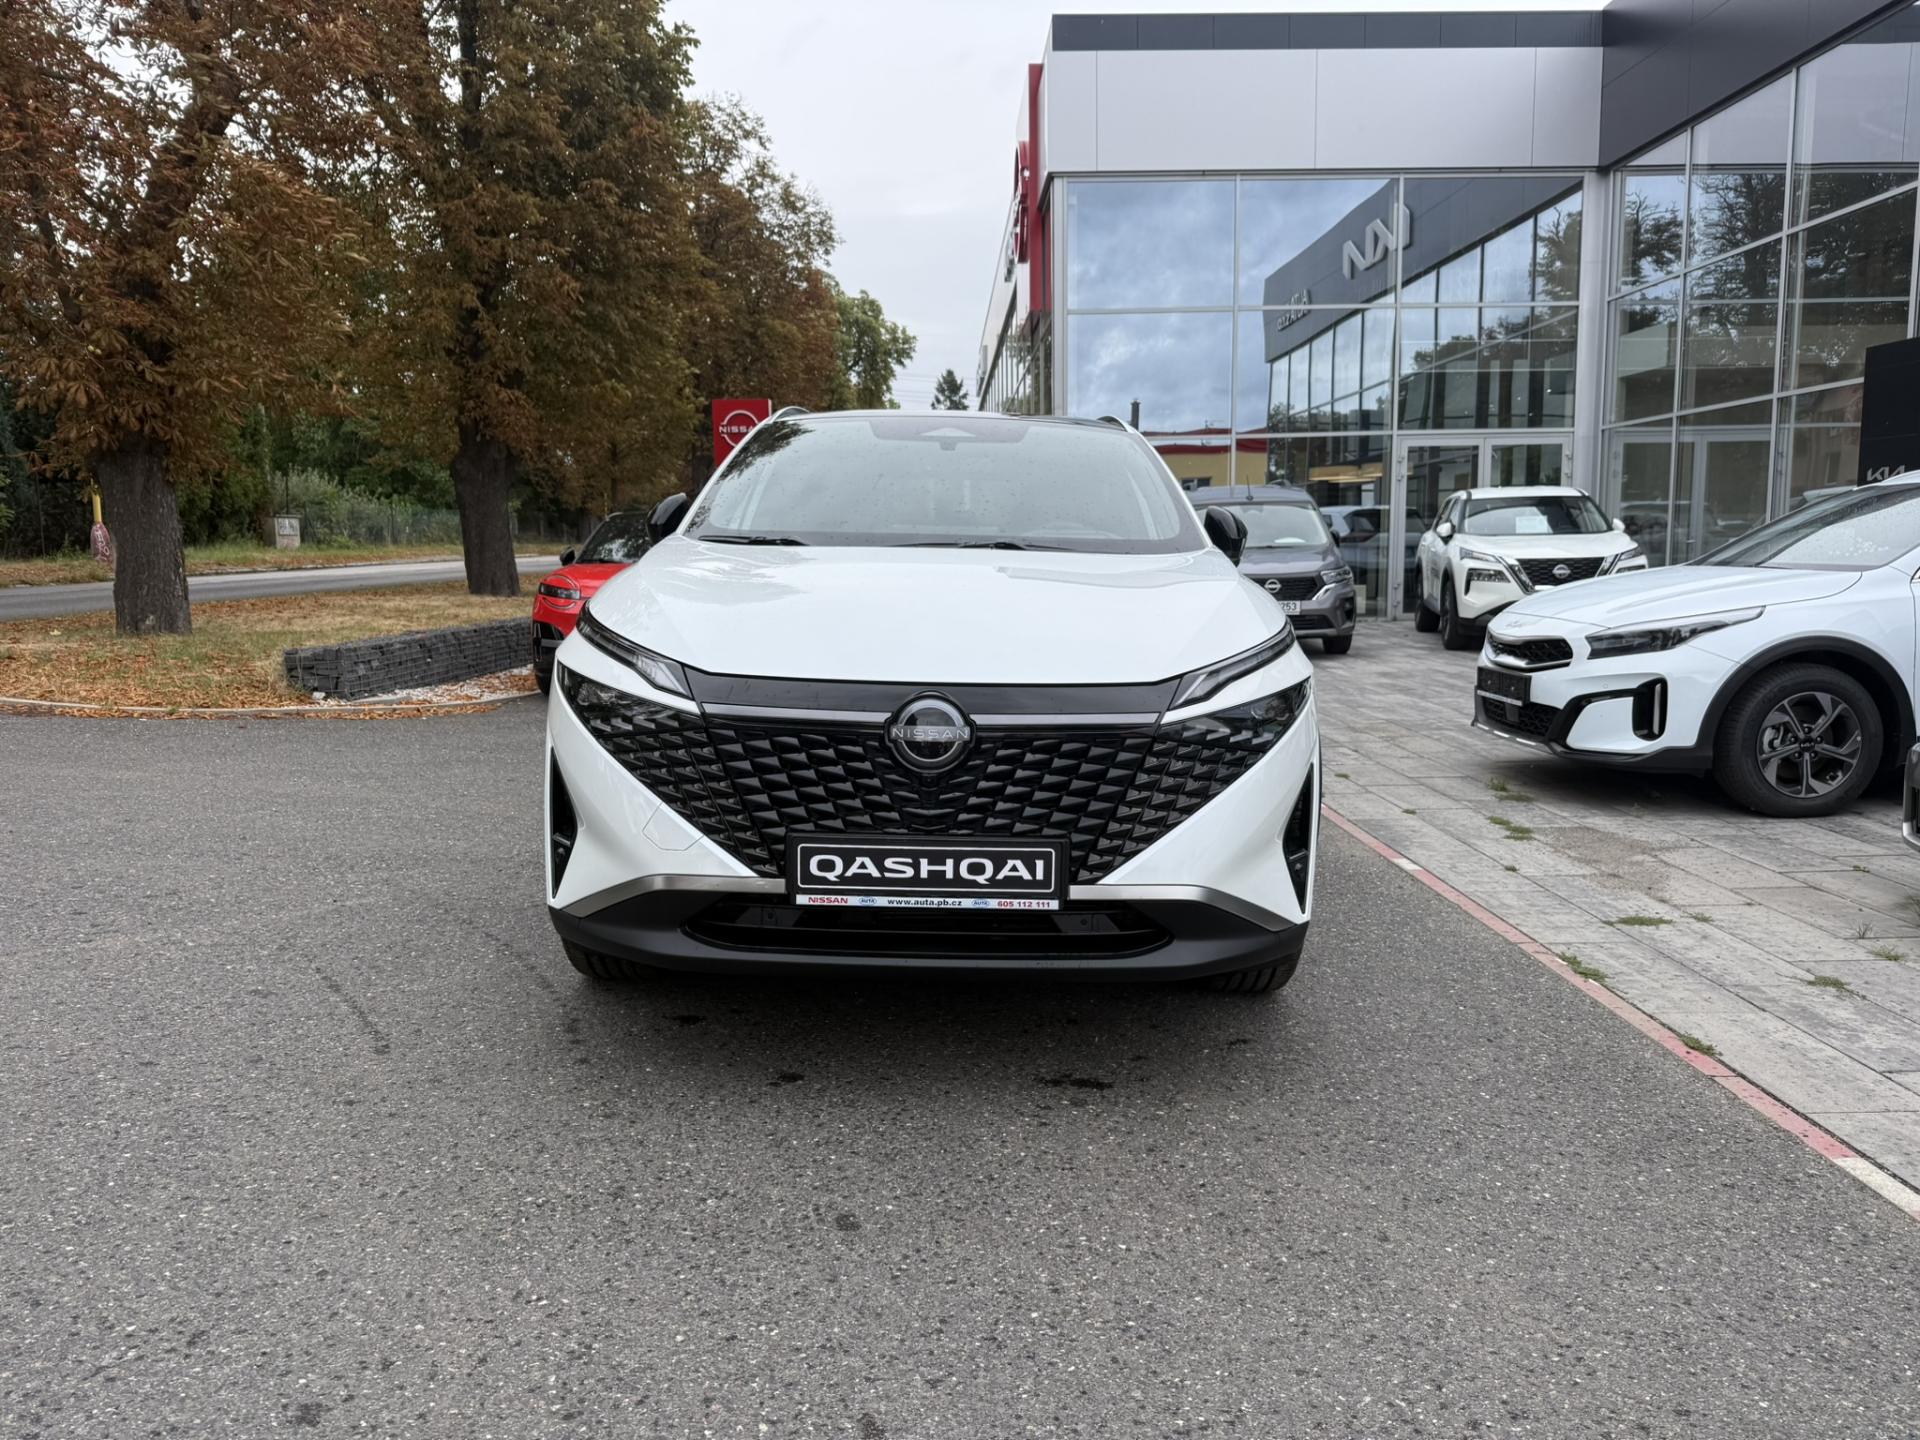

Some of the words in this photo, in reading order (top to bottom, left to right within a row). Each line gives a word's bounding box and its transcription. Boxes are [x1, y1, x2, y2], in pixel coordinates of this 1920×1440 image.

[1866, 464, 1905, 481] KIA
[1278, 602, 1297, 611] 753
[892, 728, 968, 739] NISSAN
[809, 854, 1044, 884] QASHQAI
